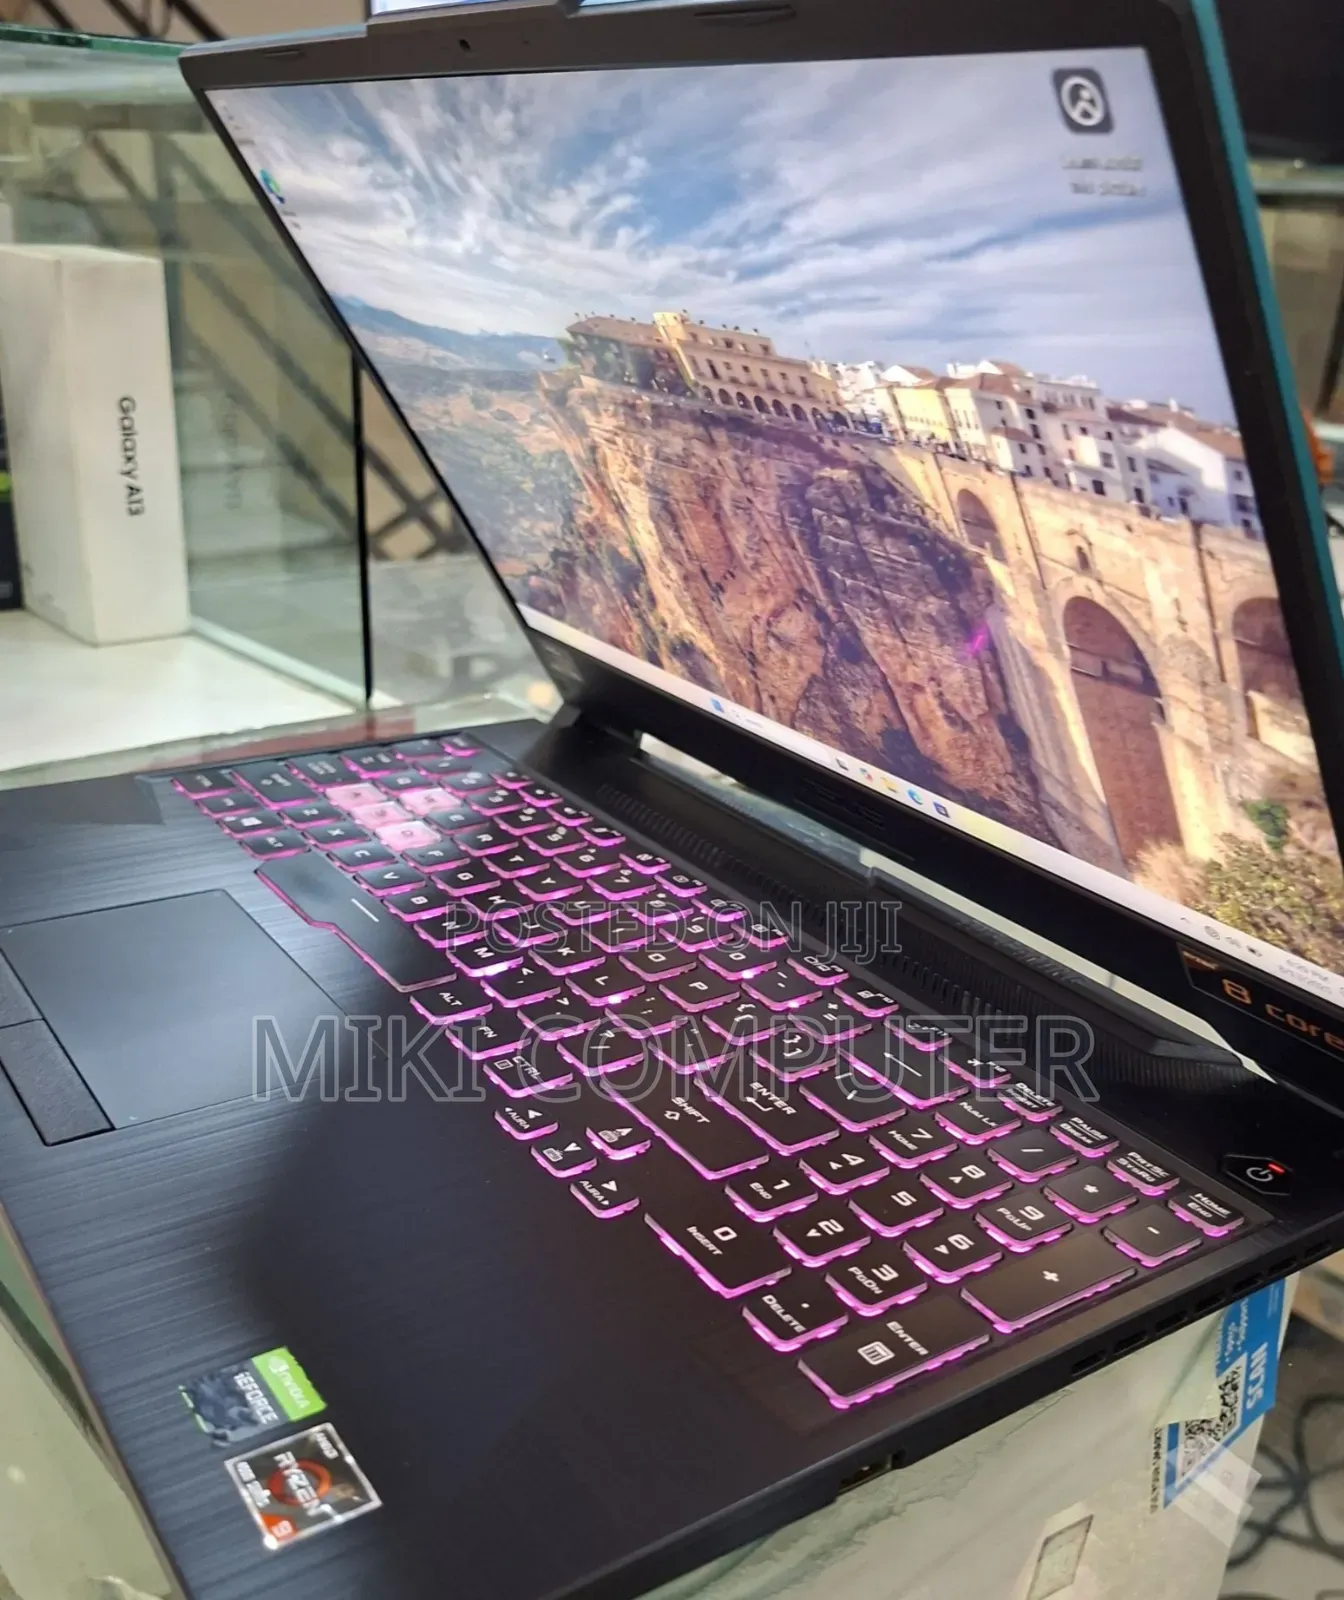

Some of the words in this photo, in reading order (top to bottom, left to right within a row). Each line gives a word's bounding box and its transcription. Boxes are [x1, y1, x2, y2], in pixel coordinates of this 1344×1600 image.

[118, 395, 139, 479] Galaxy
[125, 483, 145, 516] A13
[476, 833, 494, 843] R
[354, 849, 371, 858] C
[427, 850, 444, 858] F
[579, 854, 595, 863] 6
[383, 872, 401, 880] V
[457, 872, 474, 881] G
[540, 878, 557, 886] Y
[410, 896, 429, 905] B
[488, 895, 506, 904] H
[574, 900, 592, 910] U
[442, 921, 461, 931] N
[522, 921, 540, 930] J
[473, 947, 495, 958] M
[557, 947, 576, 957] K
[648, 953, 667, 962] O
[594, 975, 610, 986] L
[689, 981, 709, 991] P
[1221, 978, 1252, 1005] 8
[439, 991, 463, 1007] ALT
[477, 1026, 498, 1038] FN
[512, 1055, 541, 1080] CTRL
[749, 1081, 797, 1116] ENTER
[671, 1097, 711, 1124] SHIFT
[507, 1111, 531, 1130] AURA
[910, 1128, 934, 1140] 7
[841, 1153, 866, 1166] 4
[961, 1164, 987, 1179] 8
[774, 1179, 791, 1190] 1
[579, 1180, 606, 1202] AURA
[890, 1191, 918, 1207] 5
[1018, 1206, 1045, 1221] 9
[817, 1218, 845, 1236] 2
[686, 1225, 723, 1256] INSERT
[947, 1233, 975, 1251] 6
[871, 1263, 900, 1282] 3
[762, 1294, 807, 1334] DELETE
[886, 1321, 929, 1356] ENTER
[273, 1451, 331, 1517] RYZEN
